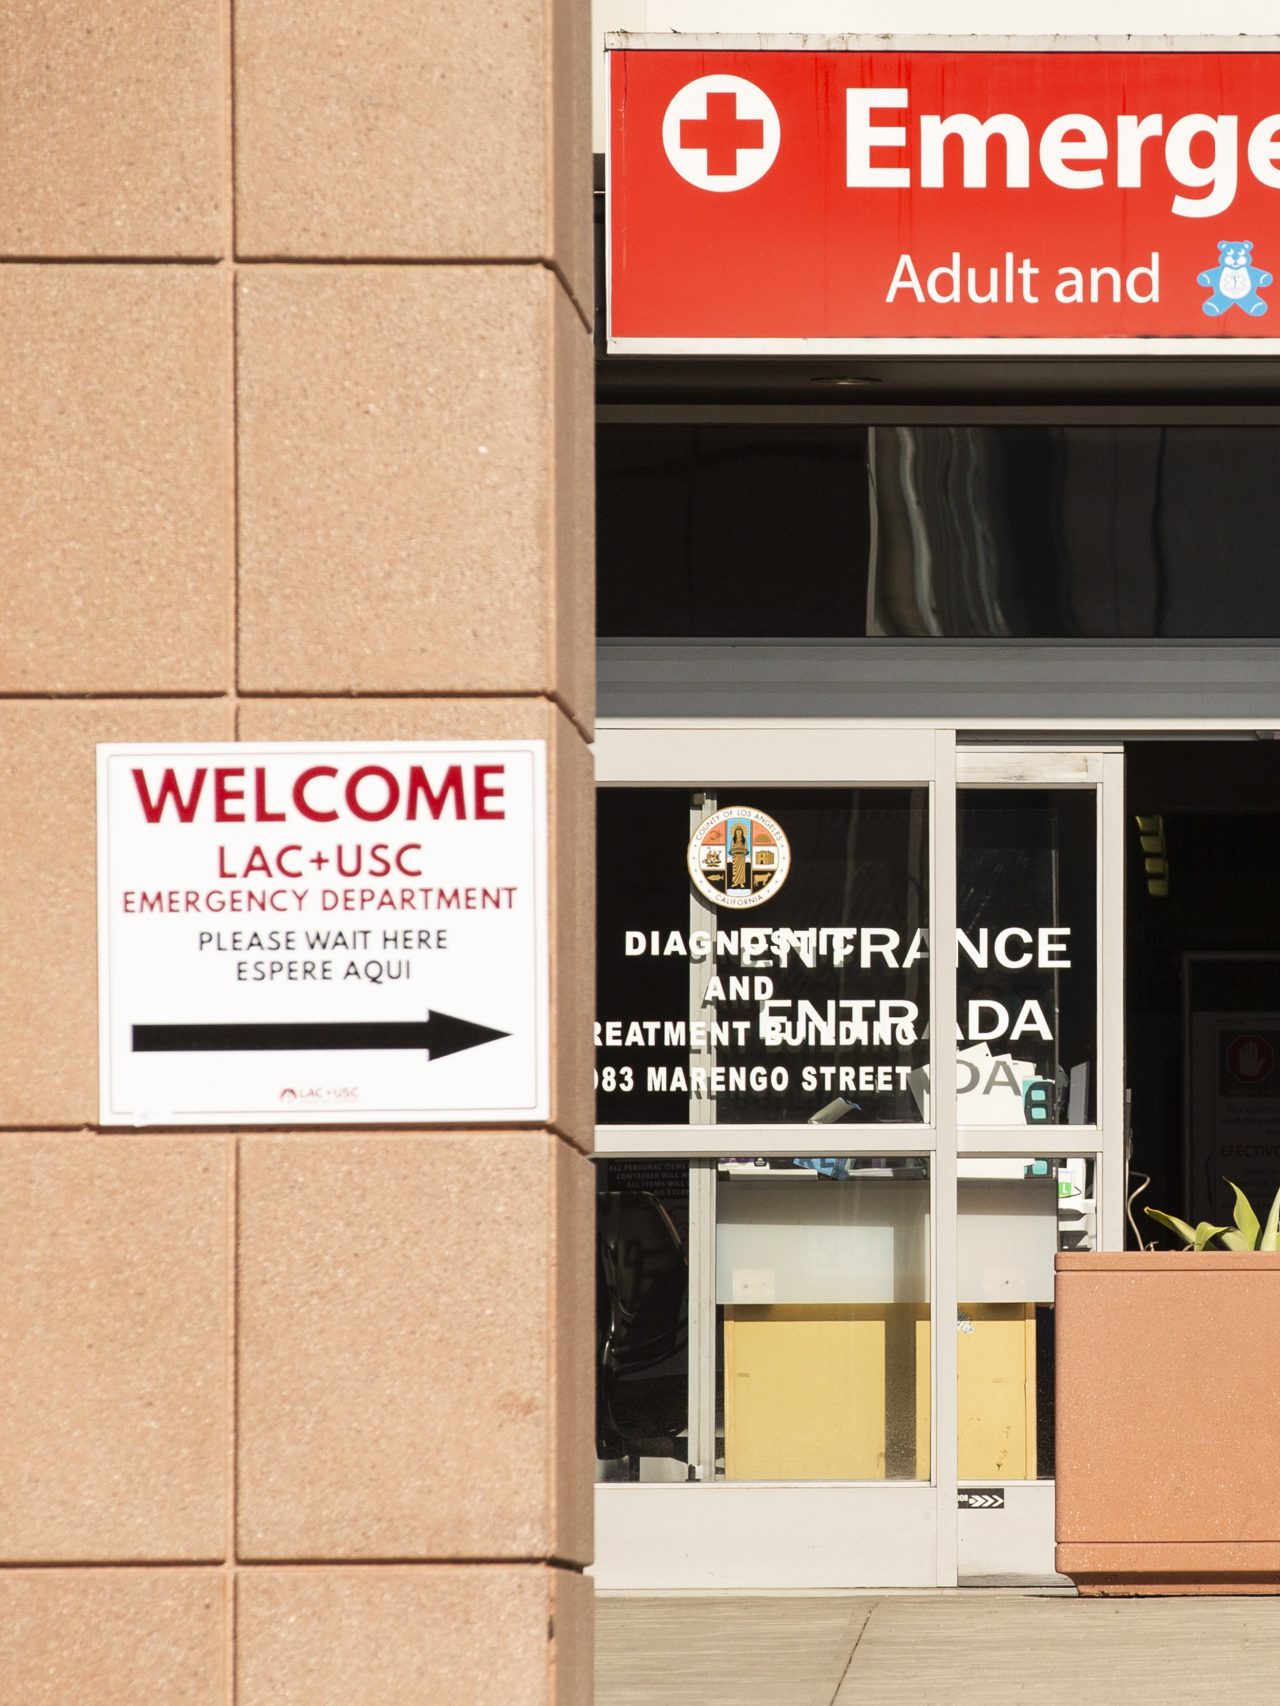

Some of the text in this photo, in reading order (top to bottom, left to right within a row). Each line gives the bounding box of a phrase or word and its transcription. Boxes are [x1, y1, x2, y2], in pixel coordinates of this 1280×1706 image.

[885, 251, 1039, 304] Adult
[1055, 251, 1161, 304] and
[131, 764, 506, 824] WELCOME
[696, 809, 782, 841] COUNTY OF LOS ANGELES
[218, 843, 423, 878] LAC+USC
[123, 887, 518, 913] EMERGENCY DEPARTMENT
[715, 894, 763, 906] CALIFORNIA
[198, 929, 448, 951] PLEASE WAIT HERE
[236, 959, 412, 984] ESPERE AQUI
[705, 976, 774, 1001] AND
[594, 1021, 751, 1046] REATMENT
[647, 1066, 790, 1092] MARENGO
[801, 1065, 912, 1092] STREET
